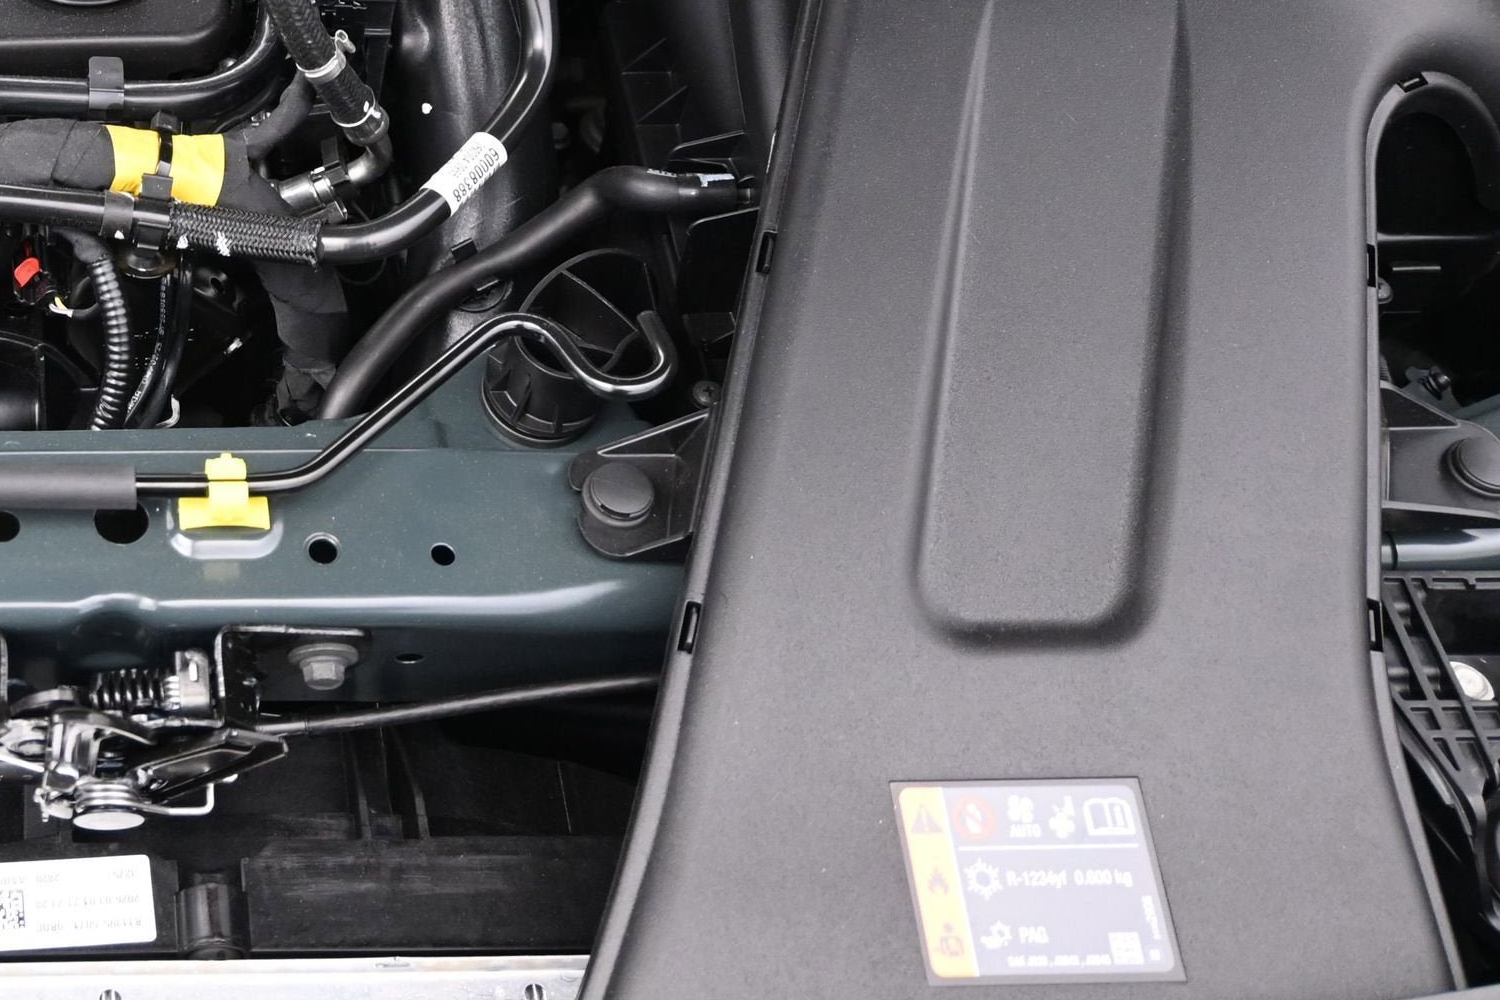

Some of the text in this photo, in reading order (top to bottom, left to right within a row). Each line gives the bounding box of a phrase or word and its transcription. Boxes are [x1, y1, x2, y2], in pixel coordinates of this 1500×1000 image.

[1009, 824, 1042, 838] AUTO
[1006, 870, 1068, 889] R-1234yf
[1113, 869, 1133, 888] kg
[1018, 928, 1050, 944] PAG
